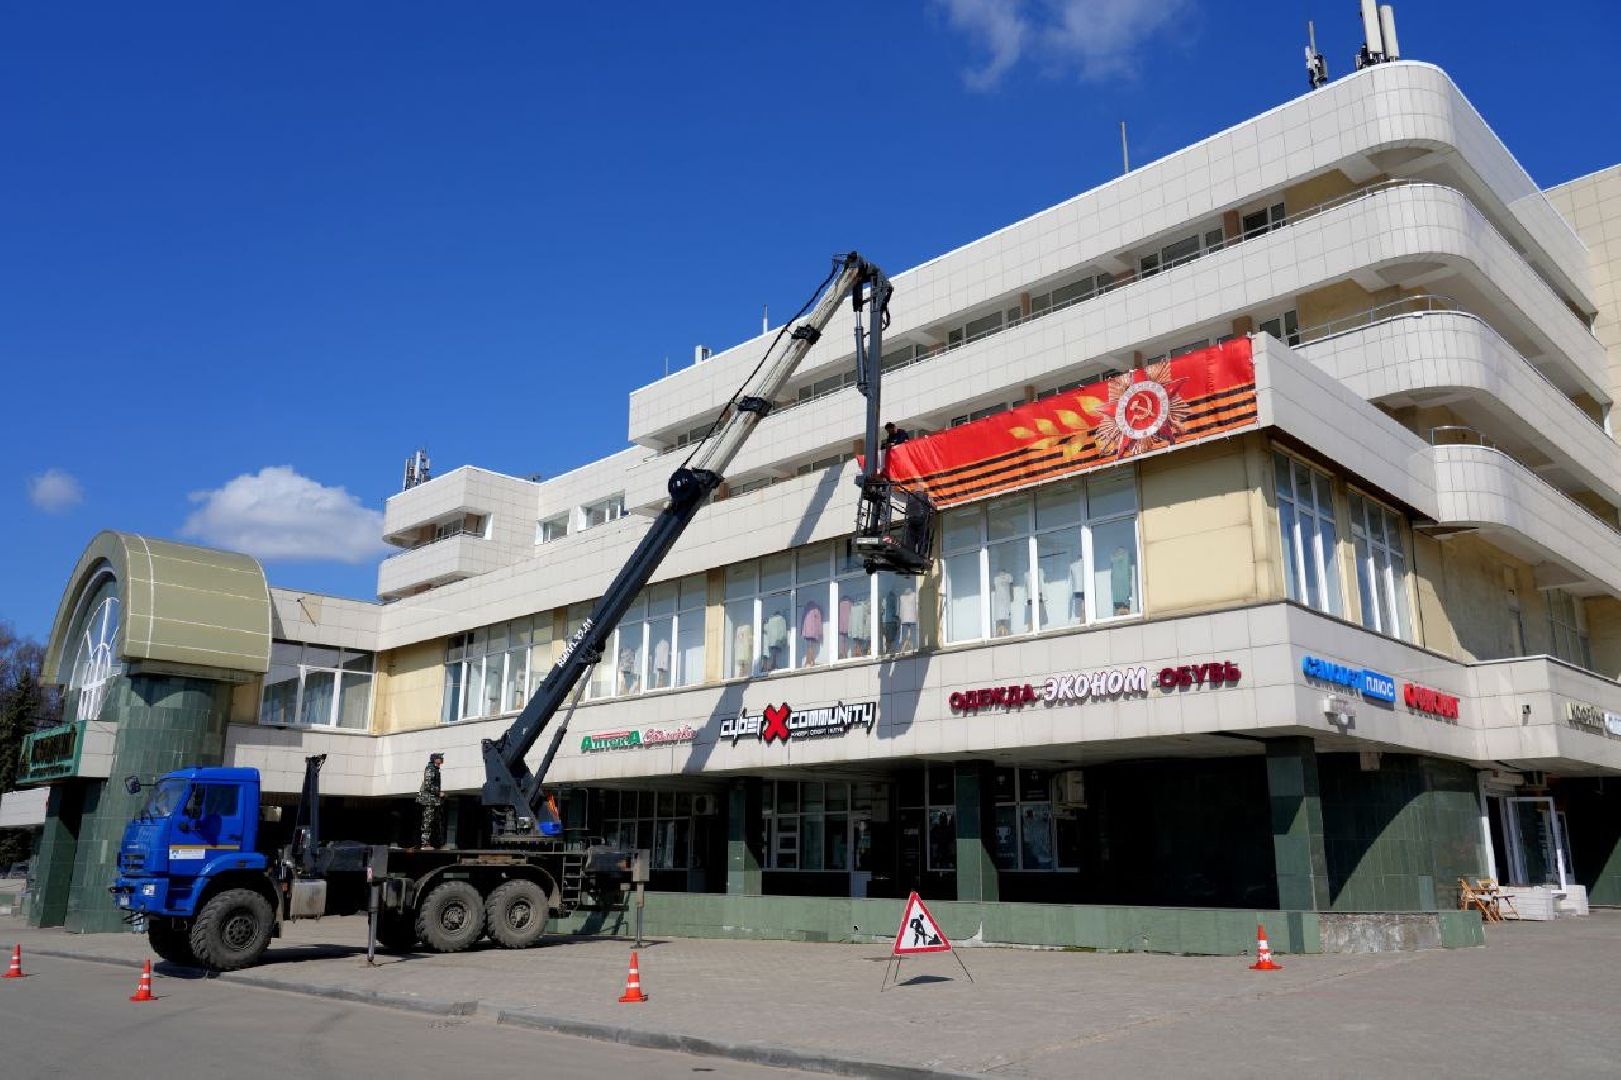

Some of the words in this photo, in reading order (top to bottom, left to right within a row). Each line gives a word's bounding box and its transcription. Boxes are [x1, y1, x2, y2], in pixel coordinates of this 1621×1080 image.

[949, 684, 1038, 711] ОДЕЖДА
[1044, 667, 1149, 701] ЭКОНОМ
[1159, 660, 1242, 688] ОБУВЬ
